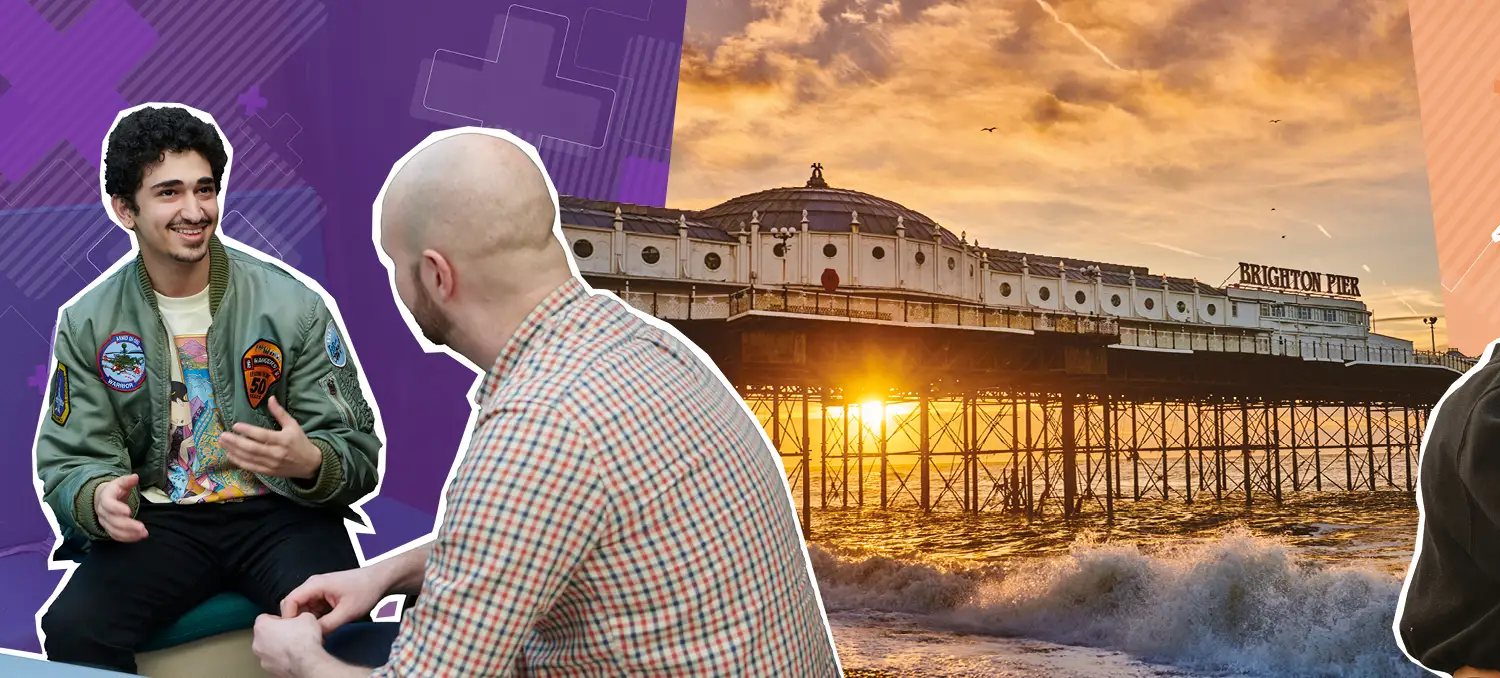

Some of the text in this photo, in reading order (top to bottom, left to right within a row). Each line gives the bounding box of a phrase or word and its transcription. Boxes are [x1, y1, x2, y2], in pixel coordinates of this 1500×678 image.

[1239, 262, 1361, 297] BRIGHTON PIER
[108, 379, 134, 389] WARRIOR
[250, 377, 266, 395] 50
